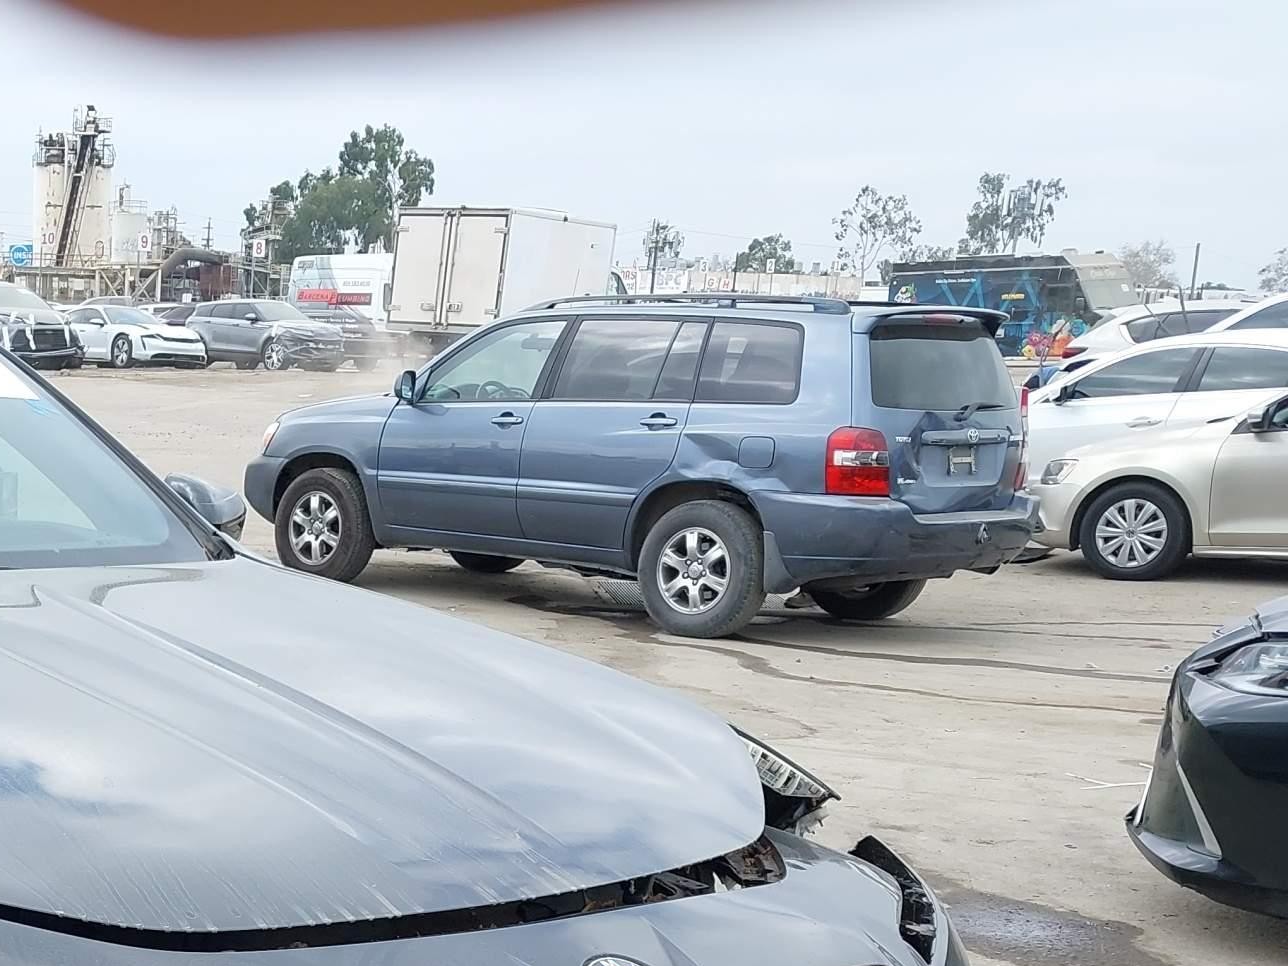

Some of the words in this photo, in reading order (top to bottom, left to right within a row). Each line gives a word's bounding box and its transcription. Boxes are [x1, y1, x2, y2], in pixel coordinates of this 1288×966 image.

[41, 232, 55, 245] 10
[140, 235, 148, 248] 9
[255, 242, 263, 255] 8
[701, 261, 707, 272] 3
[767, 260, 774, 272] 2
